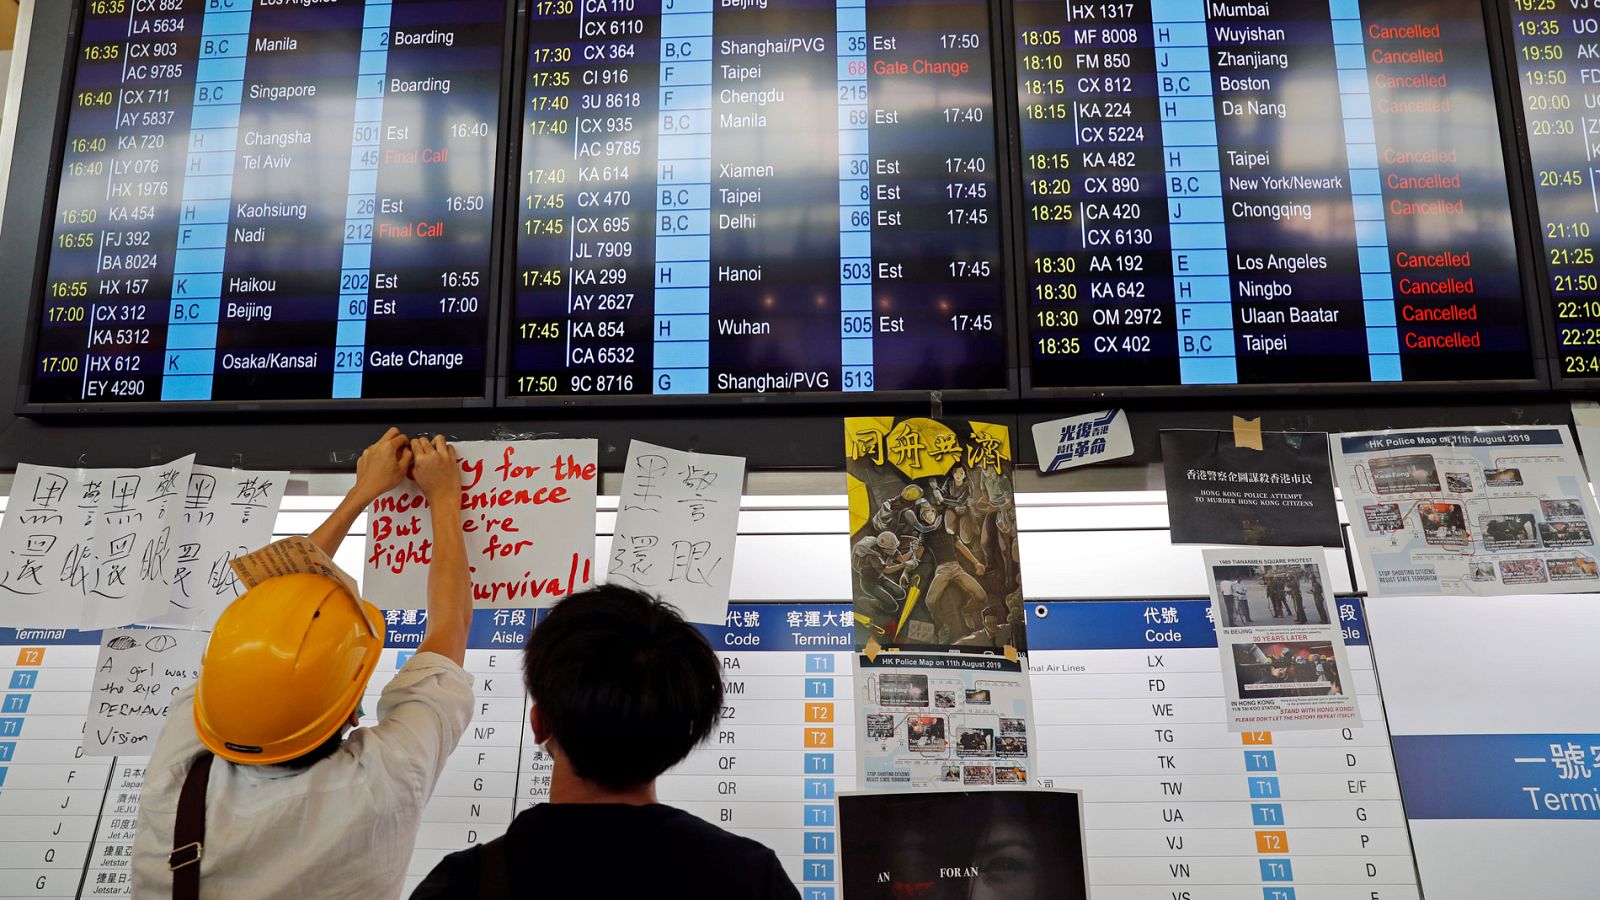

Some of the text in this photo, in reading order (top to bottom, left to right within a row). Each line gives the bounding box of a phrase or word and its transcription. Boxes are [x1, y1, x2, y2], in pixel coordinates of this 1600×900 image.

[1518, 20, 1559, 36] 19:35
[84, 30, 454, 60] 16:35 CX 903 B,C Manila 2 Boarding
[534, 35, 979, 63] 17:30 CX 364 B,C Shanghai/PVG 35 Est 17:50
[1030, 172, 1461, 195] 18:20 CX 890 B,C New York/Newark Cancelled
[1539, 171, 1582, 186] 20:45
[1550, 248, 1594, 264] 21:25
[522, 262, 990, 286] 17:45 KA 299 H Hanoi 503 Est 17:45
[1037, 305, 1477, 328] 18:30 OM 2972 F Ulaan Baatar Cancelled
[42, 351, 463, 372] 17:00 HX 612 K Osaka/Kansai 213 Gate Change
[1369, 439, 1384, 448] HK
[1386, 437, 1415, 446] Police
[1417, 436, 1437, 446] Map
[1452, 436, 1470, 444] 11th
[1473, 435, 1506, 445] August
[1508, 434, 1530, 443] 2019
[495, 446, 540, 482] for
[551, 454, 596, 481] the
[373, 516, 421, 541] But
[482, 535, 533, 560] for
[493, 610, 526, 626] 行段
[726, 611, 760, 628] 代號
[787, 611, 854, 628] 客運大樓
[1144, 606, 1178, 624] 代號
[15, 629, 66, 640] Terminal
[492, 630, 524, 644] Aisle
[724, 632, 760, 646] Code
[792, 631, 852, 646] Terminal
[1146, 629, 1182, 642] Code
[919, 660, 934, 668] Map
[962, 661, 985, 669] August
[1148, 656, 1164, 667] LX
[101, 657, 113, 672] A
[128, 662, 154, 682] girl
[166, 669, 186, 678] was
[100, 683, 124, 694] the
[1149, 680, 1165, 692] FD
[98, 727, 148, 745] Vision
[719, 732, 827, 745] PR T2
[718, 757, 736, 771] QF
[718, 782, 736, 796] QR
[1160, 780, 1367, 795] TW T1 E/F
[1167, 835, 1369, 850] VJ T2 P
[878, 867, 978, 882] AN FOR AN
